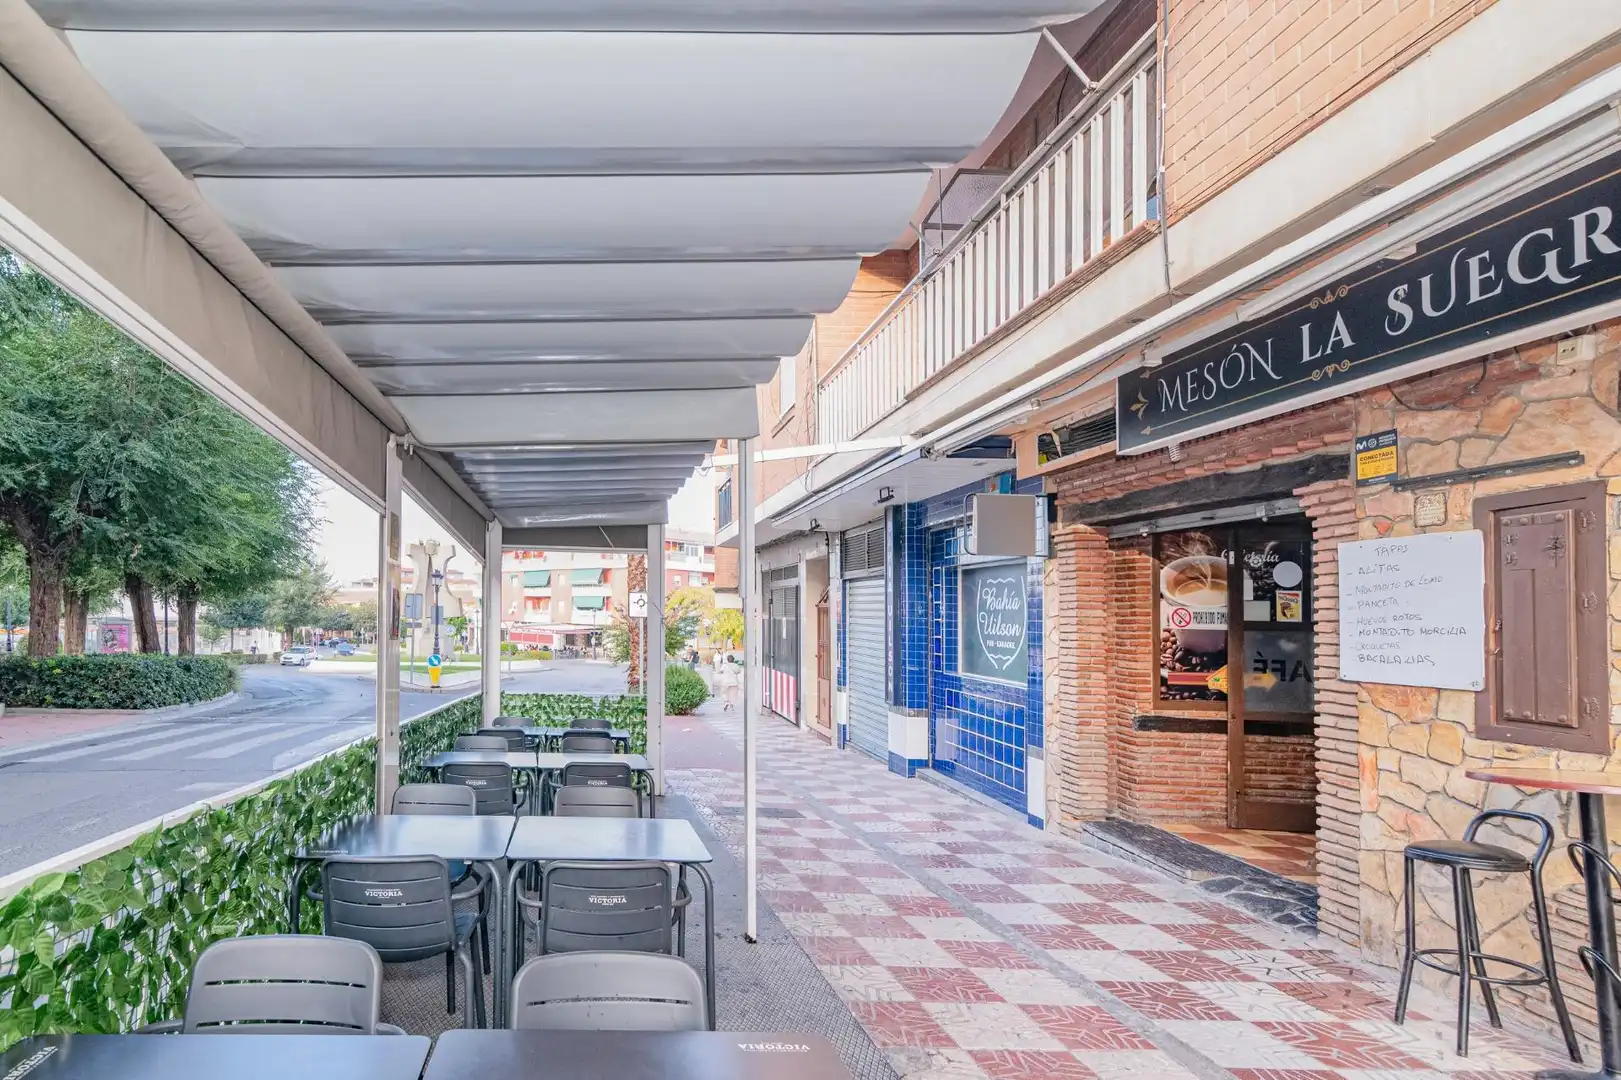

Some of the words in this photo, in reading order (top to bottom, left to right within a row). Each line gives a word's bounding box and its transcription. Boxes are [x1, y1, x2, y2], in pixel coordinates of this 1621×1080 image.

[1159, 338, 1282, 413] MESÓN
[1300, 310, 1356, 363] LA
[1384, 206, 1621, 336] SUEGR
[1360, 450, 1394, 462] CONECTADA
[1374, 545, 1409, 557] TAPAS
[982, 587, 1021, 611] Bahía
[1357, 597, 1399, 610] PANCETA
[1393, 613, 1423, 622] ROTOS
